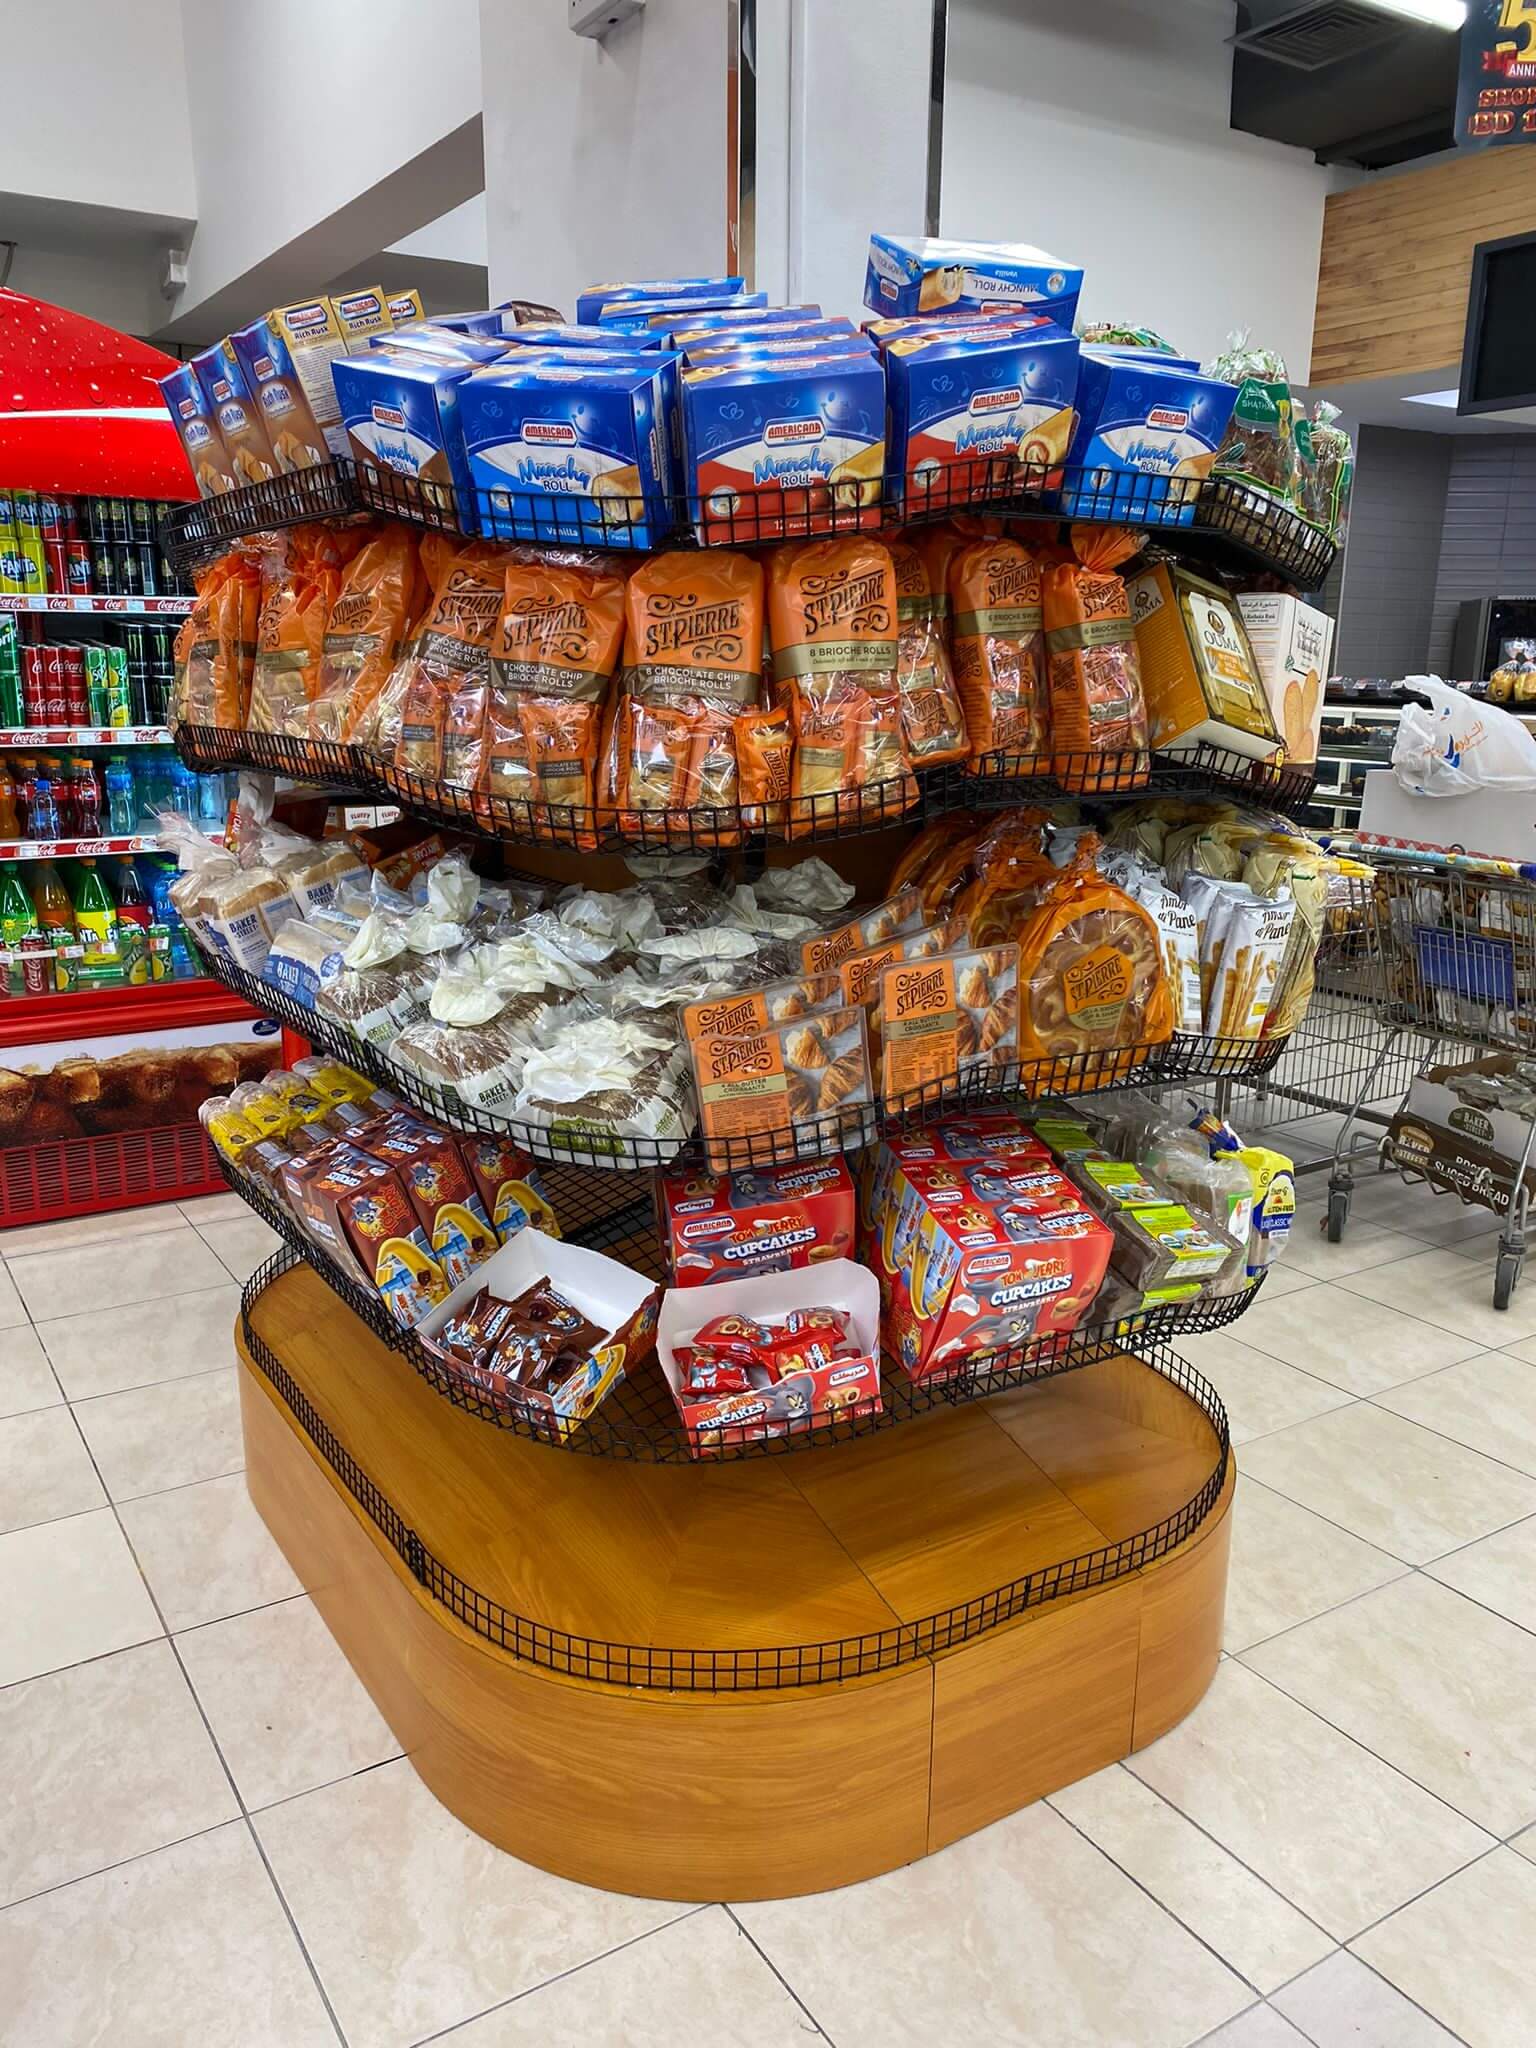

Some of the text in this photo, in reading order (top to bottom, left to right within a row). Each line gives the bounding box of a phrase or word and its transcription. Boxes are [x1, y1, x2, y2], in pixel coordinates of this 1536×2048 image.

[364, 316, 382, 327] Rusk
[294, 326, 328, 340] Rich Rusk
[973, 392, 1021, 408] AMERICANA
[1150, 410, 1187, 425] AMERICANA
[525, 425, 573, 439] AMERICANA
[768, 422, 821, 438] AMERICANA
[954, 414, 1027, 453] Munchy
[373, 435, 419, 473] Munchy
[977, 440, 1007, 455] ROLL
[1123, 438, 1180, 471] Munchy
[518, 454, 592, 490] Munchy
[753, 446, 834, 485] Munchy
[1139, 460, 1162, 473] ROLL
[543, 479, 573, 492] ROLL
[780, 473, 814, 488] ROLL
[993, 612, 1022, 621] BRIOCHE
[1090, 624, 1119, 633] BRIOCHE
[432, 635, 478, 657] CHOCOLATE
[1203, 630, 1241, 654] OUMA
[810, 646, 891, 658] 8 BRIOCHE ROLLS
[508, 663, 557, 677] CHOCOLATE
[559, 669, 583, 681] CHIP
[508, 671, 539, 683] BRIOCHE
[541, 676, 574, 689] ROLLS
[646, 667, 741, 682] 8 CHOCOLATE CHIP
[653, 675, 732, 690] BRIOCHE ROLLS
[306, 882, 333, 900] BAKER
[1161, 894, 1190, 912] Amor
[228, 913, 258, 934] BAKER
[1168, 911, 1196, 929] Pane
[235, 924, 258, 938] STREET
[1263, 921, 1291, 940] Pane
[277, 961, 299, 982] BAKER
[478, 1082, 507, 1103] BAKER
[1463, 1112, 1490, 1131] BAKER
[775, 1168, 841, 1191] CUPCAKES
[686, 1219, 732, 1235] AMERICANA
[729, 1215, 805, 1244] TOM JERRY
[723, 1227, 817, 1260] CUPCAKES
[742, 1245, 805, 1266] STRAWBERRY
[970, 1256, 1009, 1269] AMERICANA
[1001, 1259, 1066, 1286] TOM JERRY
[990, 1274, 1073, 1306] CUPCAKES
[696, 1396, 755, 1418] TOM JERRY
[696, 1400, 767, 1430] CUPCAKES
